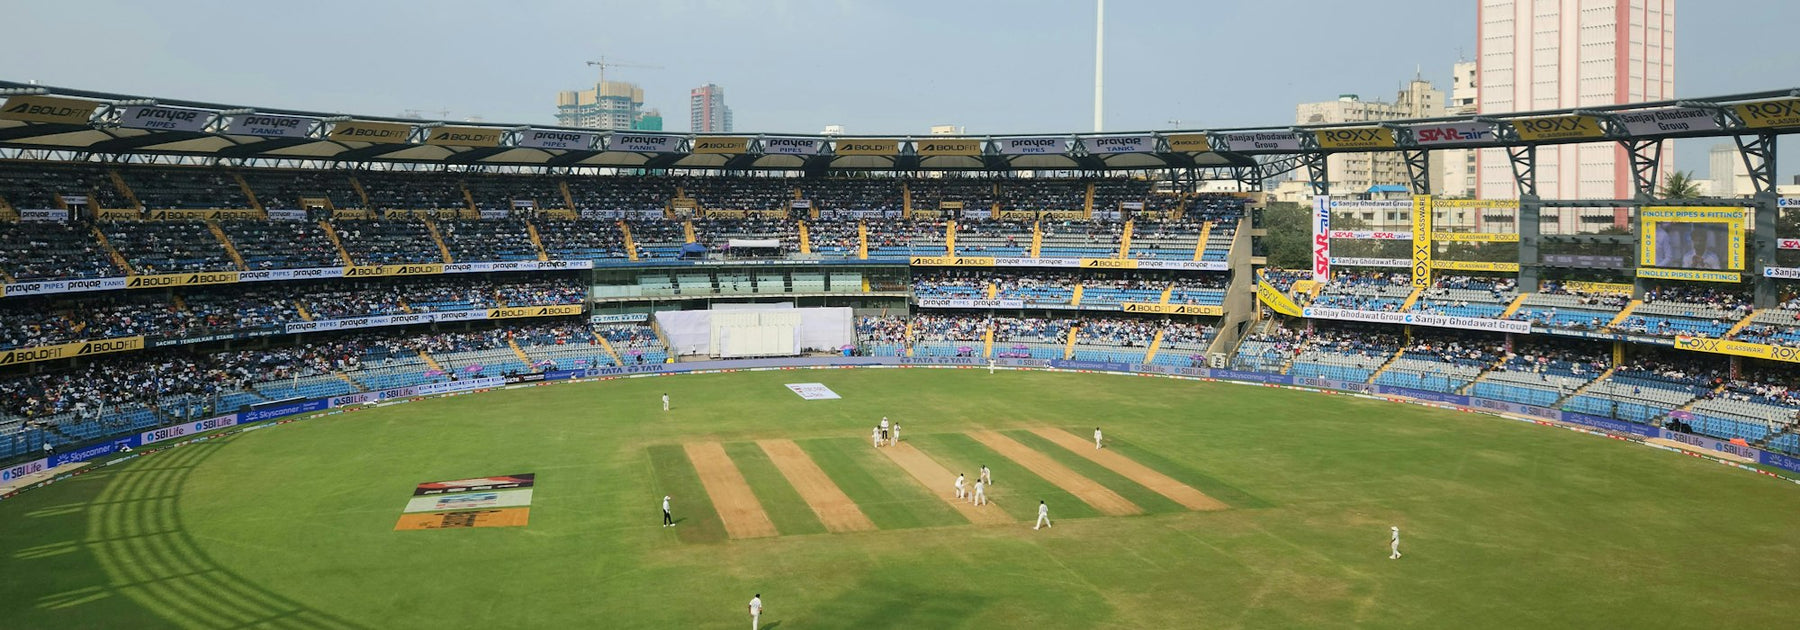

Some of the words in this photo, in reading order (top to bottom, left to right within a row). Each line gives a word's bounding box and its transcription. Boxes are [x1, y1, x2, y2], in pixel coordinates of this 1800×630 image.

[136, 107, 197, 122] prayag
[1621, 111, 1655, 124] Sanjay
[1655, 108, 1708, 121] Ghodawat
[145, 120, 176, 129] PIPES
[243, 116, 300, 128] prayag
[1522, 116, 1588, 133] ROXX
[1658, 121, 1690, 131] Group
[534, 132, 580, 142] prayag
[621, 136, 667, 145] prayag
[1096, 137, 1141, 146] prayag
[1228, 133, 1255, 143] Sanjay
[1256, 132, 1296, 141] Ghodawat
[1324, 129, 1382, 142] ROXX
[770, 139, 813, 147] prayag
[1011, 139, 1055, 148] prayag
[1254, 141, 1279, 149] Group
[1393, 200, 1413, 208] Group
[444, 263, 471, 271] prayag
[492, 262, 518, 270] prayag
[1415, 245, 1428, 287] ROXX
[240, 271, 270, 280] prayag
[293, 269, 322, 278] prayag
[1638, 269, 1669, 277] FINOLEX
[1702, 273, 1738, 281] FITTINGS
[5, 283, 41, 294] prayag
[68, 280, 100, 290] prayag
[1313, 308, 1339, 318] Sanjay
[1341, 310, 1379, 319] Ghodawat
[1380, 312, 1404, 321] Group
[288, 322, 317, 332] prayag
[341, 318, 368, 328] prayag
[391, 315, 419, 324] prayag
[441, 312, 467, 320] prayag
[1415, 315, 1447, 326] Sanjay
[1449, 317, 1497, 328] Ghodawat
[1500, 321, 1528, 331] Group
[94, 339, 138, 353] BOLDFIT
[1726, 344, 1765, 353] GLASSWARE
[17, 347, 62, 360] BOLDFIT
[1193, 368, 1206, 376] Life
[1305, 378, 1317, 386] SBI
[1318, 380, 1331, 388] Life
[1348, 383, 1360, 391] SBI
[341, 396, 353, 405] SBI
[354, 394, 368, 403] Life
[386, 391, 398, 399] SBI
[399, 389, 413, 398] Life
[1482, 400, 1495, 408] SBI
[1495, 402, 1510, 411] Life
[259, 406, 299, 420] Skyscanner
[1528, 408, 1540, 416] SBI
[1541, 409, 1556, 418] Life
[203, 419, 216, 430] SBI
[217, 417, 232, 428] Life
[1584, 417, 1627, 431] Skyscanner
[155, 430, 168, 441] SBI
[169, 426, 184, 438] Life
[1673, 435, 1687, 443] SBI
[1688, 436, 1704, 447] Life
[70, 444, 110, 461] Skyscanner
[1723, 443, 1737, 453] SBI
[1738, 445, 1754, 458] Life
[11, 467, 25, 479] SBI
[26, 462, 42, 475] Life
